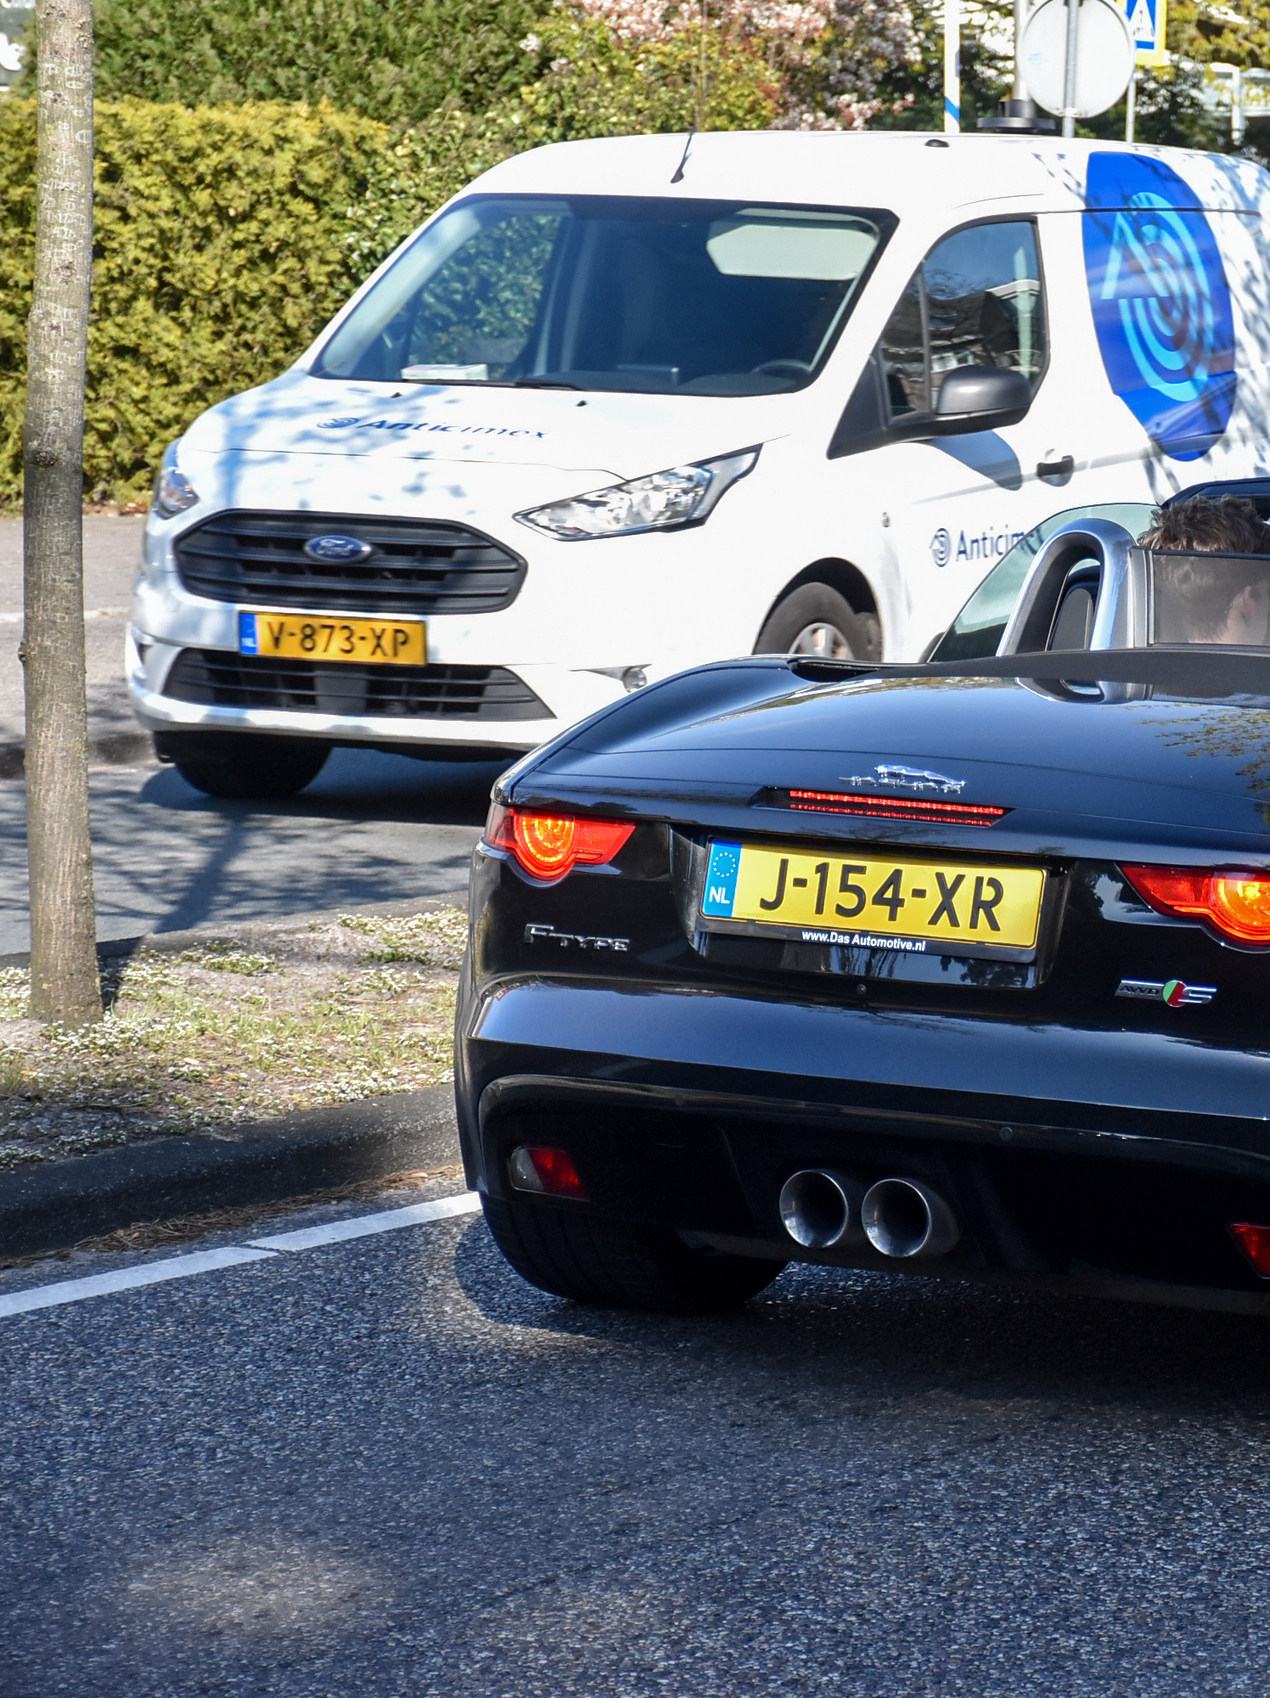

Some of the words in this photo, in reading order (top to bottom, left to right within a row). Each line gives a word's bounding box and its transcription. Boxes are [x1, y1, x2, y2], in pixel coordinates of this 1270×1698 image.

[355, 419, 548, 438] Anticimex
[316, 538, 355, 557] Ford
[267, 620, 409, 658] V-873-XP
[709, 886, 730, 904] NL
[759, 858, 1004, 932] J-154-XR
[801, 930, 849, 945] www.Das
[851, 934, 927, 952] Automotive.nl
[1119, 985, 1160, 997] AWD
